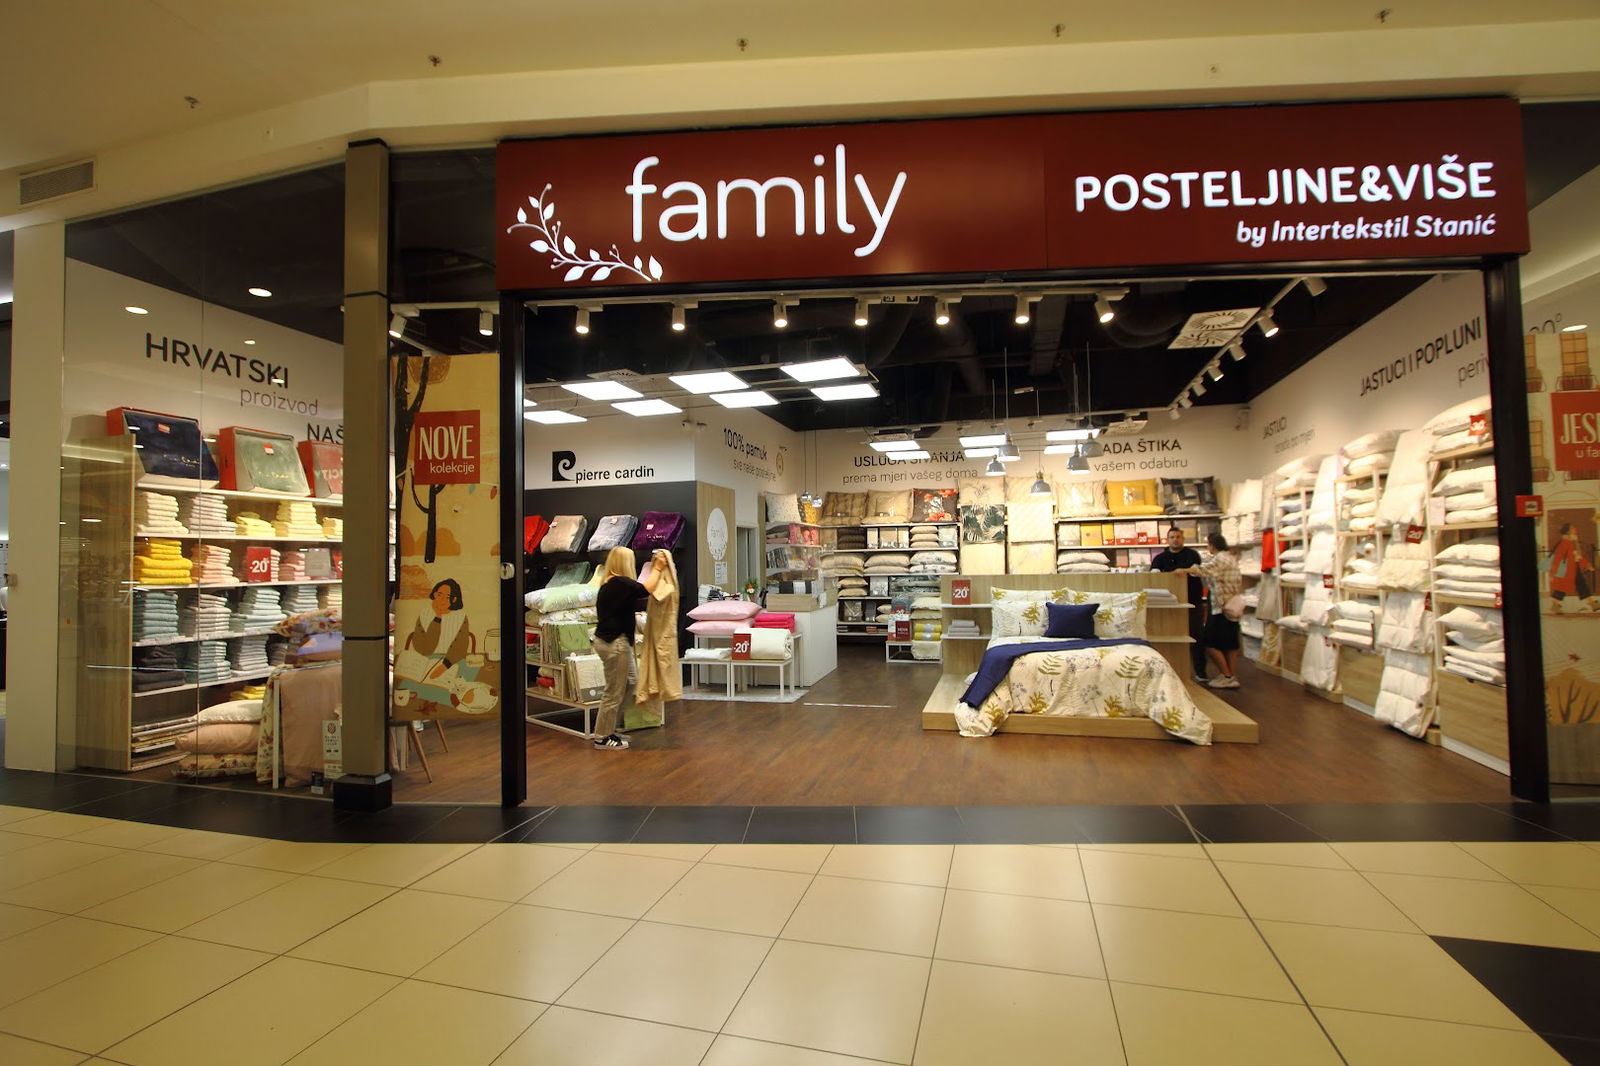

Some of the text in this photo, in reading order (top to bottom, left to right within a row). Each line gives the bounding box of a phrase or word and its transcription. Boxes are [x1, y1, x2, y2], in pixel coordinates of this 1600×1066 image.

[625, 143, 908, 257] family
[1075, 154, 1496, 213] POSTELJINE&VIŠE
[1236, 212, 1497, 248] by Intertekstil Stanić
[145, 332, 289, 389] HRVATSKI
[1360, 316, 1482, 397] JASTUCI I POPLUNI
[239, 388, 319, 416] proizvod
[419, 425, 475, 460] NOVE
[723, 427, 768, 460] 100% pamuk
[1137, 438, 1182, 453] ŠTIKA
[430, 461, 475, 475] kolekcije
[575, 465, 655, 484] pierre cardin
[843, 467, 978, 485] prema mjeri vašeg doma
[1094, 456, 1189, 472] vašem odabiru
